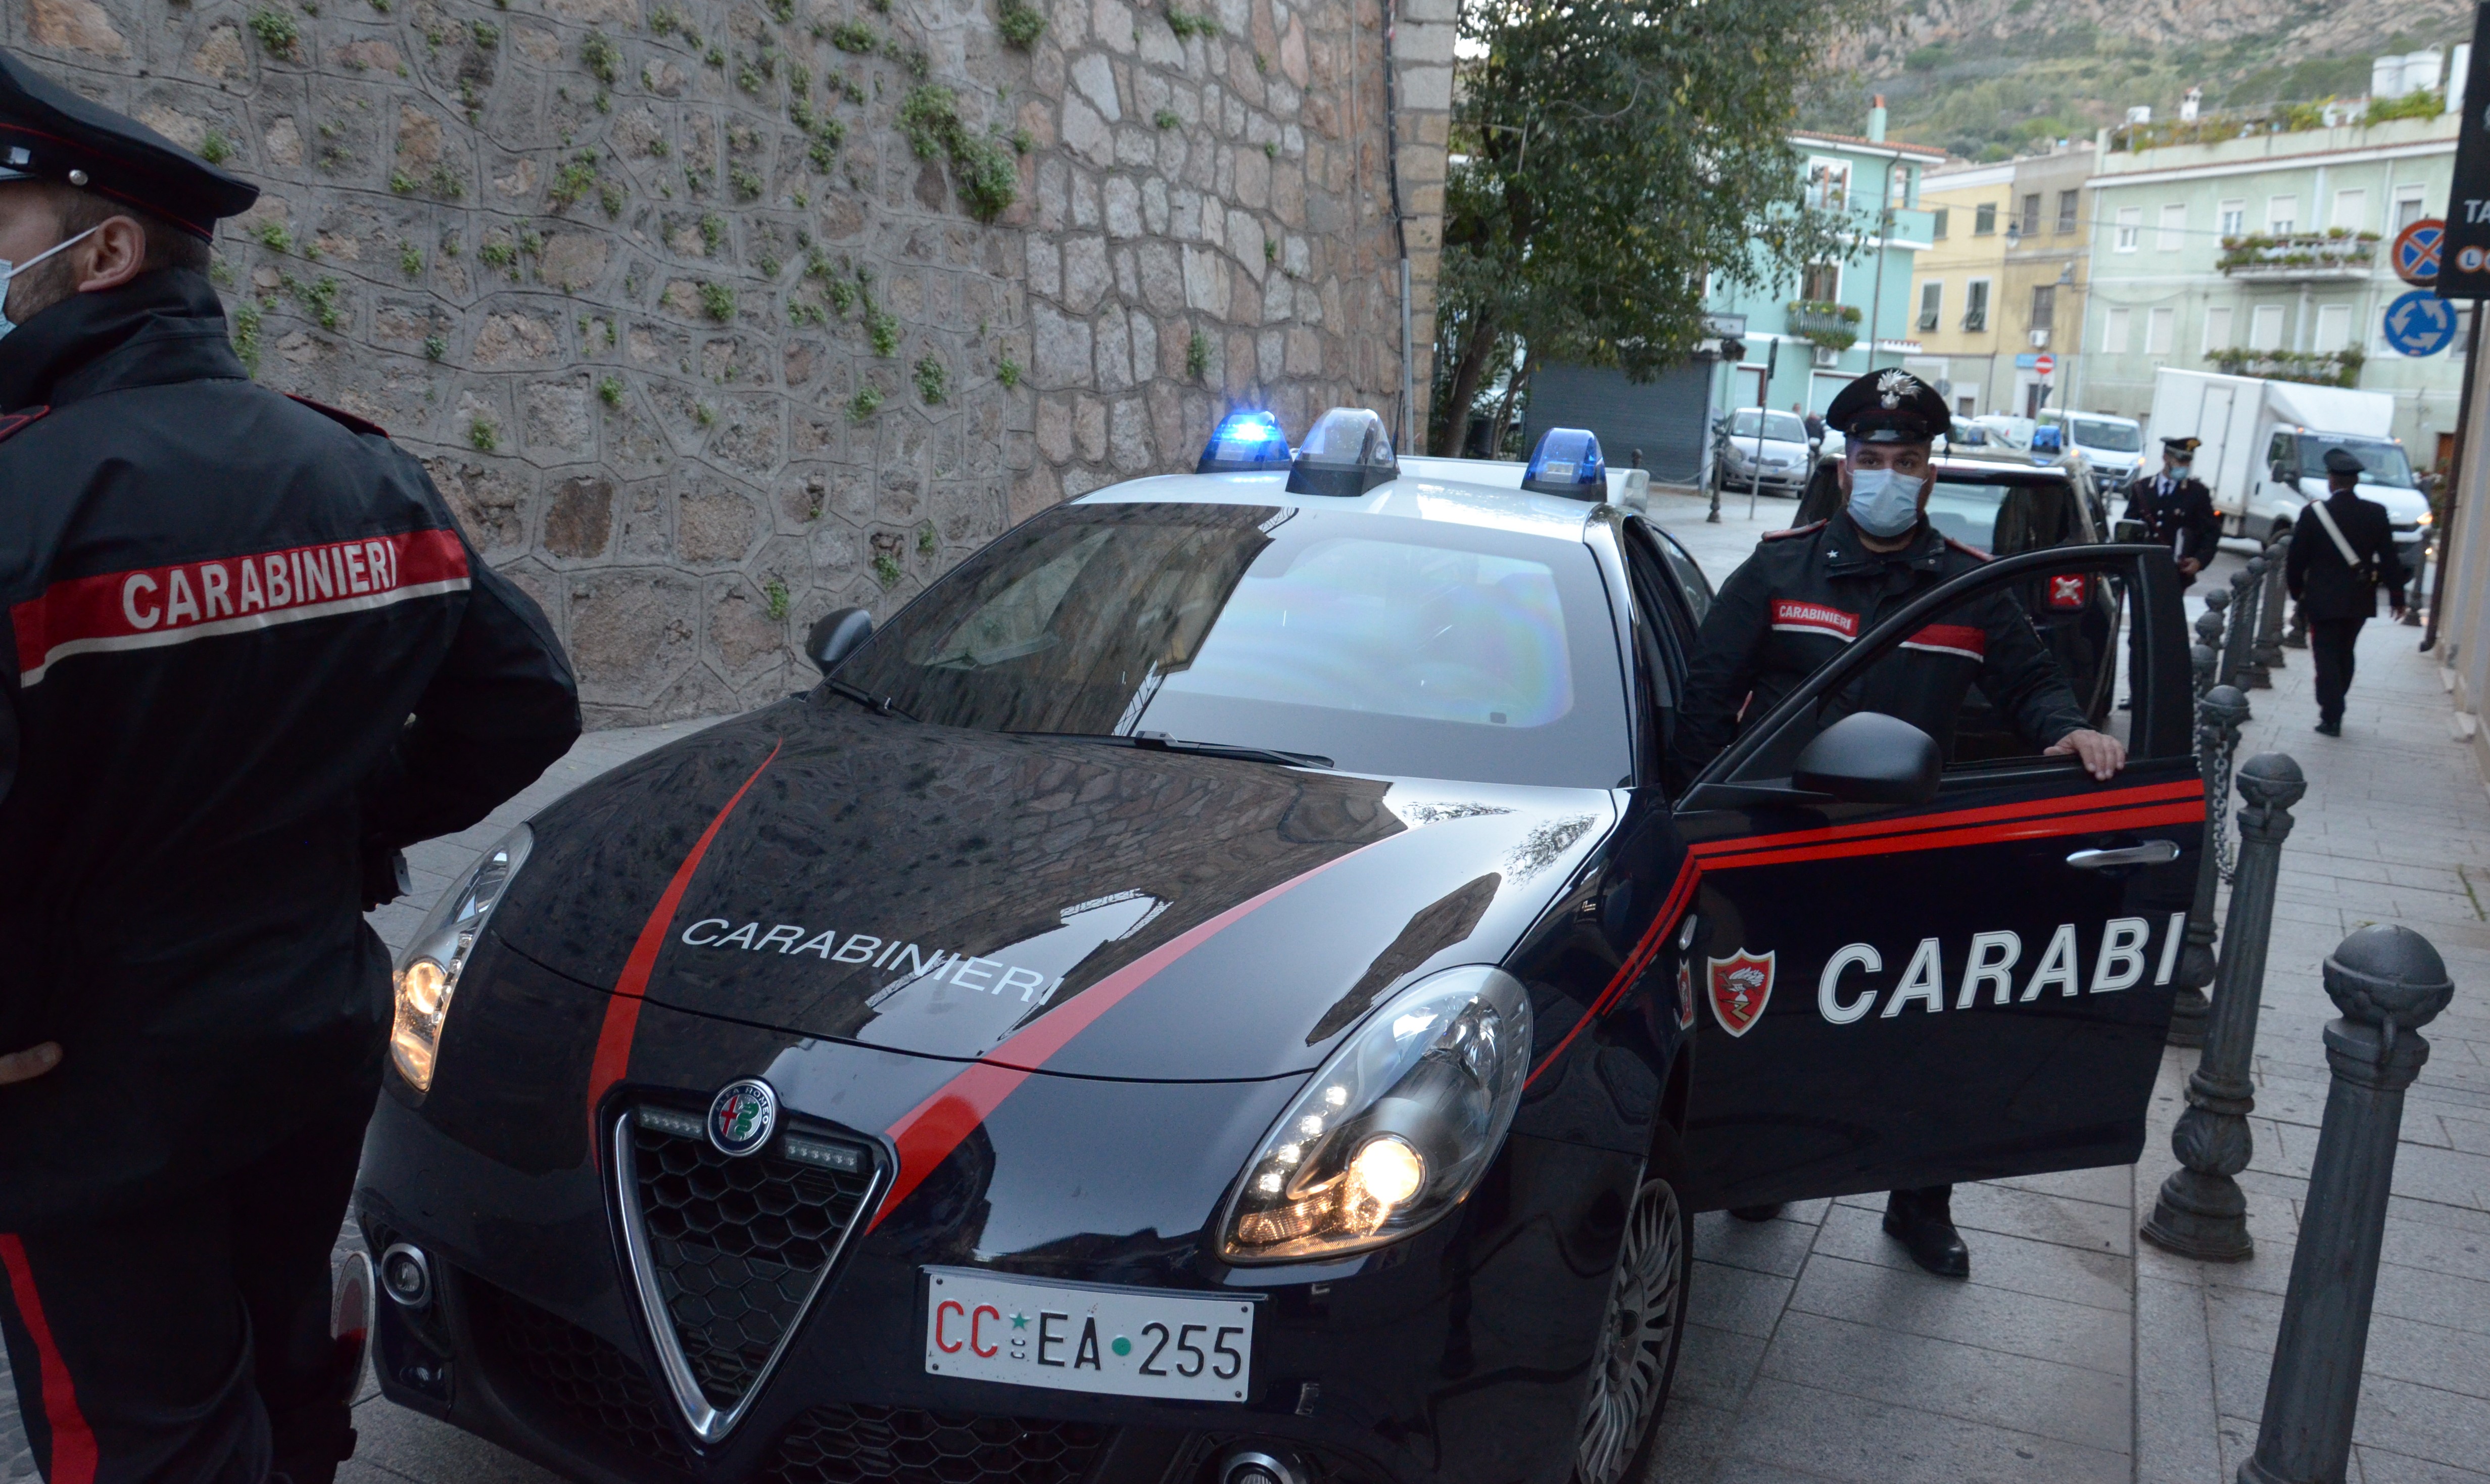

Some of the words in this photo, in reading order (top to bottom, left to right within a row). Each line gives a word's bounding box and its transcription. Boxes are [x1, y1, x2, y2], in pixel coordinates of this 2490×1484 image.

[122, 540, 397, 630] CARABINIERI
[1779, 605, 1852, 630] CARABINIERI
[681, 918, 1065, 1006] CARABINIERI
[1818, 912, 2186, 1025] CARABI
[715, 1088, 739, 1112] ALFA
[745, 1087, 769, 1124] ROMEO
[935, 1300, 999, 1358] CC
[1037, 1311, 1101, 1371] EA
[1138, 1322, 1244, 1380] 255
